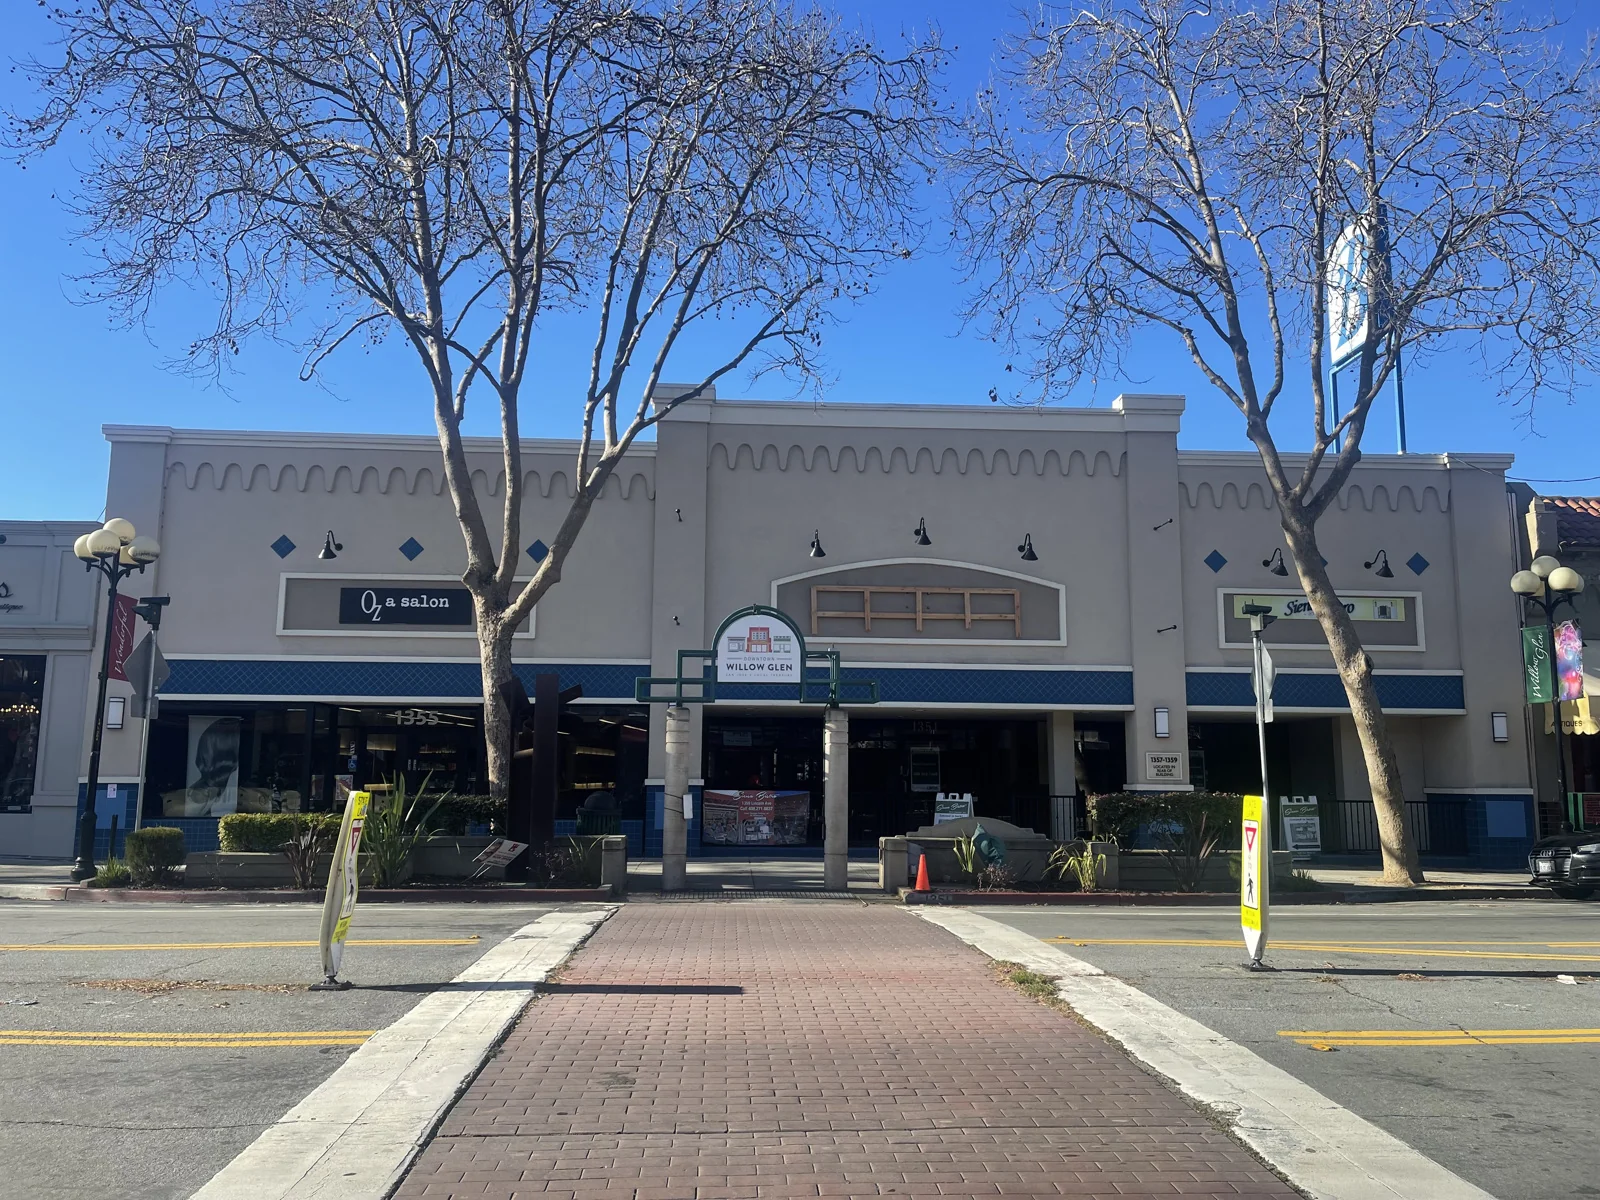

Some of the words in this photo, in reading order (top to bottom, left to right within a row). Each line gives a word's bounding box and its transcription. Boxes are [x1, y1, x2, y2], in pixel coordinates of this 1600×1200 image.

[385, 597, 396, 607] a
[400, 595, 450, 608] salon
[1284, 599, 1313, 616] Sien
[114, 601, 132, 674] Wonderful
[1531, 632, 1549, 660] Glen
[726, 663, 765, 671] WILLOW
[767, 663, 793, 671] GLEN
[1527, 655, 1542, 698] Willow
[395, 710, 439, 725] 1355
